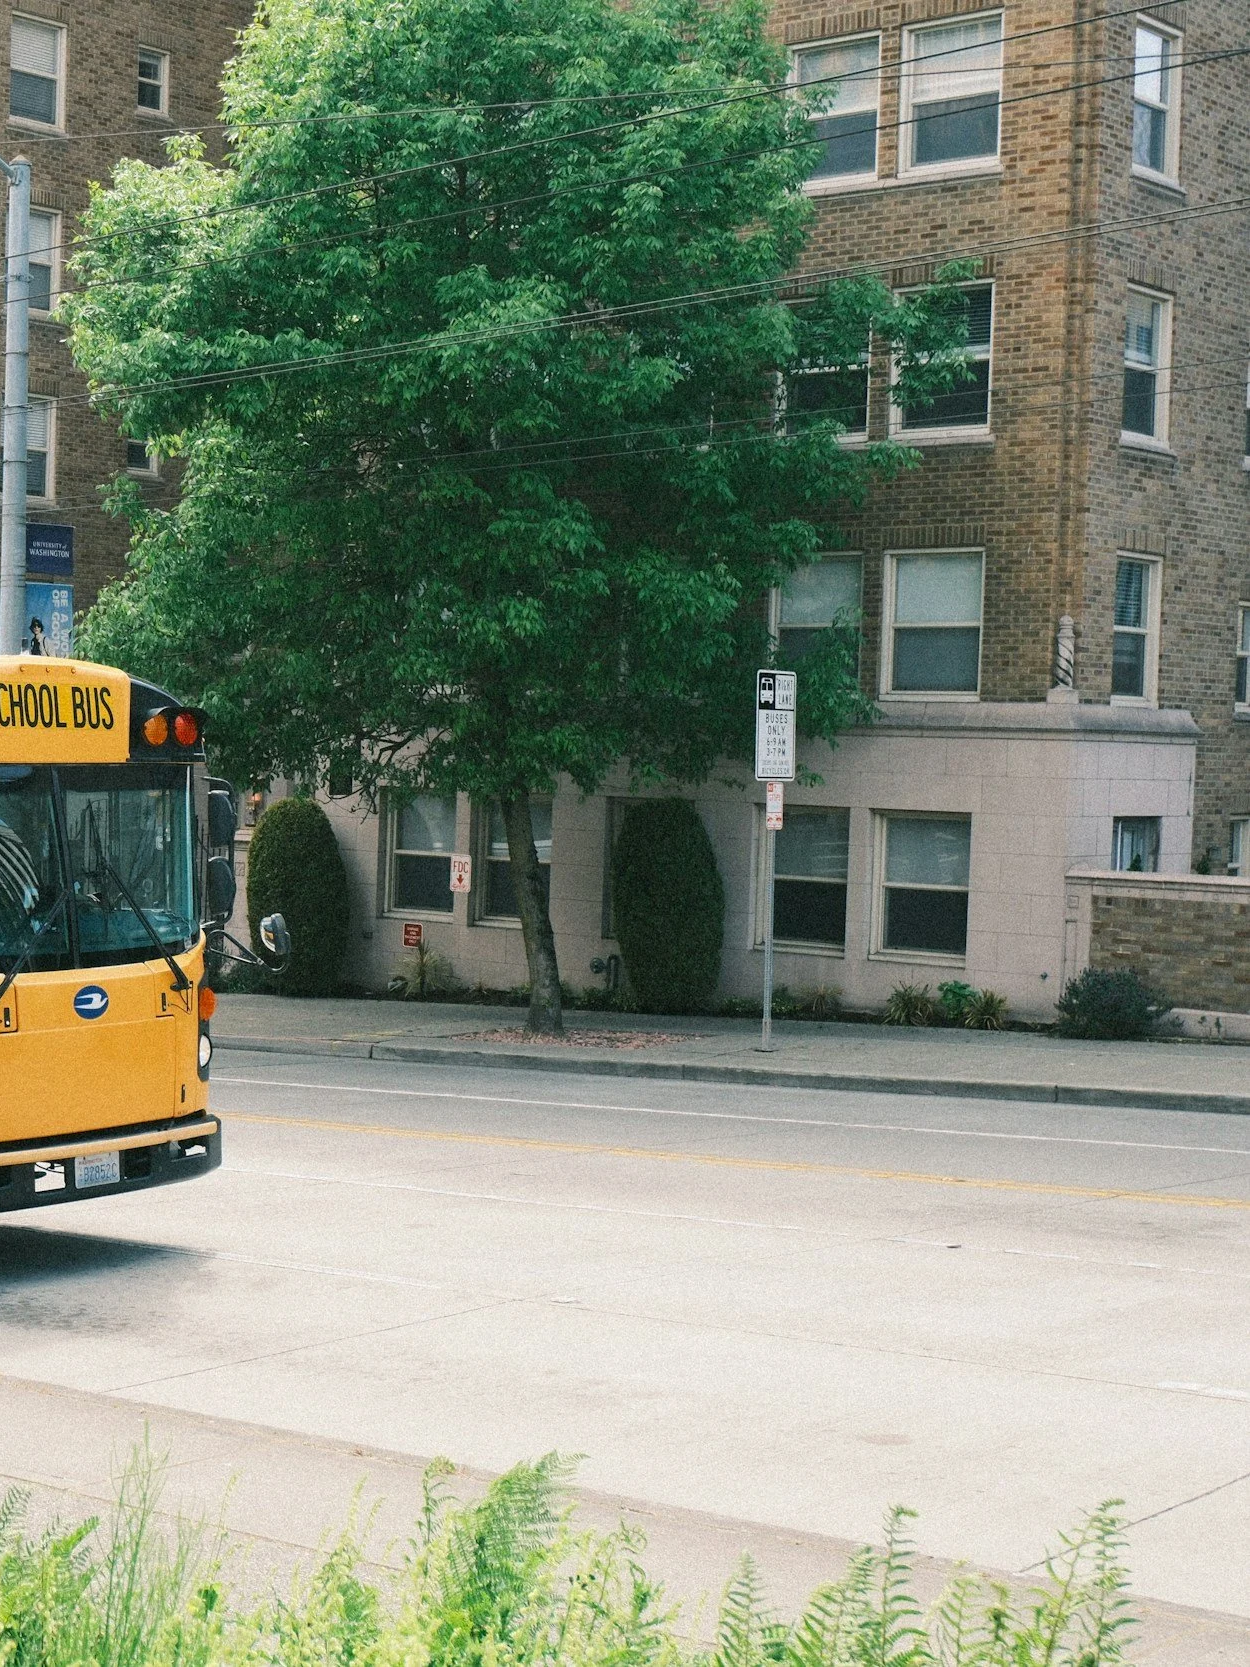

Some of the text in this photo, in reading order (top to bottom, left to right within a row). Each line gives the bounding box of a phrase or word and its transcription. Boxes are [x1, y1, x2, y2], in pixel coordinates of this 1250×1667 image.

[32, 541, 62, 549] UNIVERSITY
[29, 548, 70, 558] WASHINGTON
[60, 590, 69, 607] BE
[52, 589, 60, 650] OF GOOD
[60, 613, 69, 623] A
[778, 679, 793, 691] RIGHT
[779, 694, 792, 706] LANE
[71, 686, 114, 730] BUS
[765, 713, 788, 724] BUSES
[767, 725, 786, 736] ONLY
[766, 737, 786, 746] 6-9 AM
[766, 747, 786, 757] 3-7 PM
[453, 861, 469, 874] FDC
